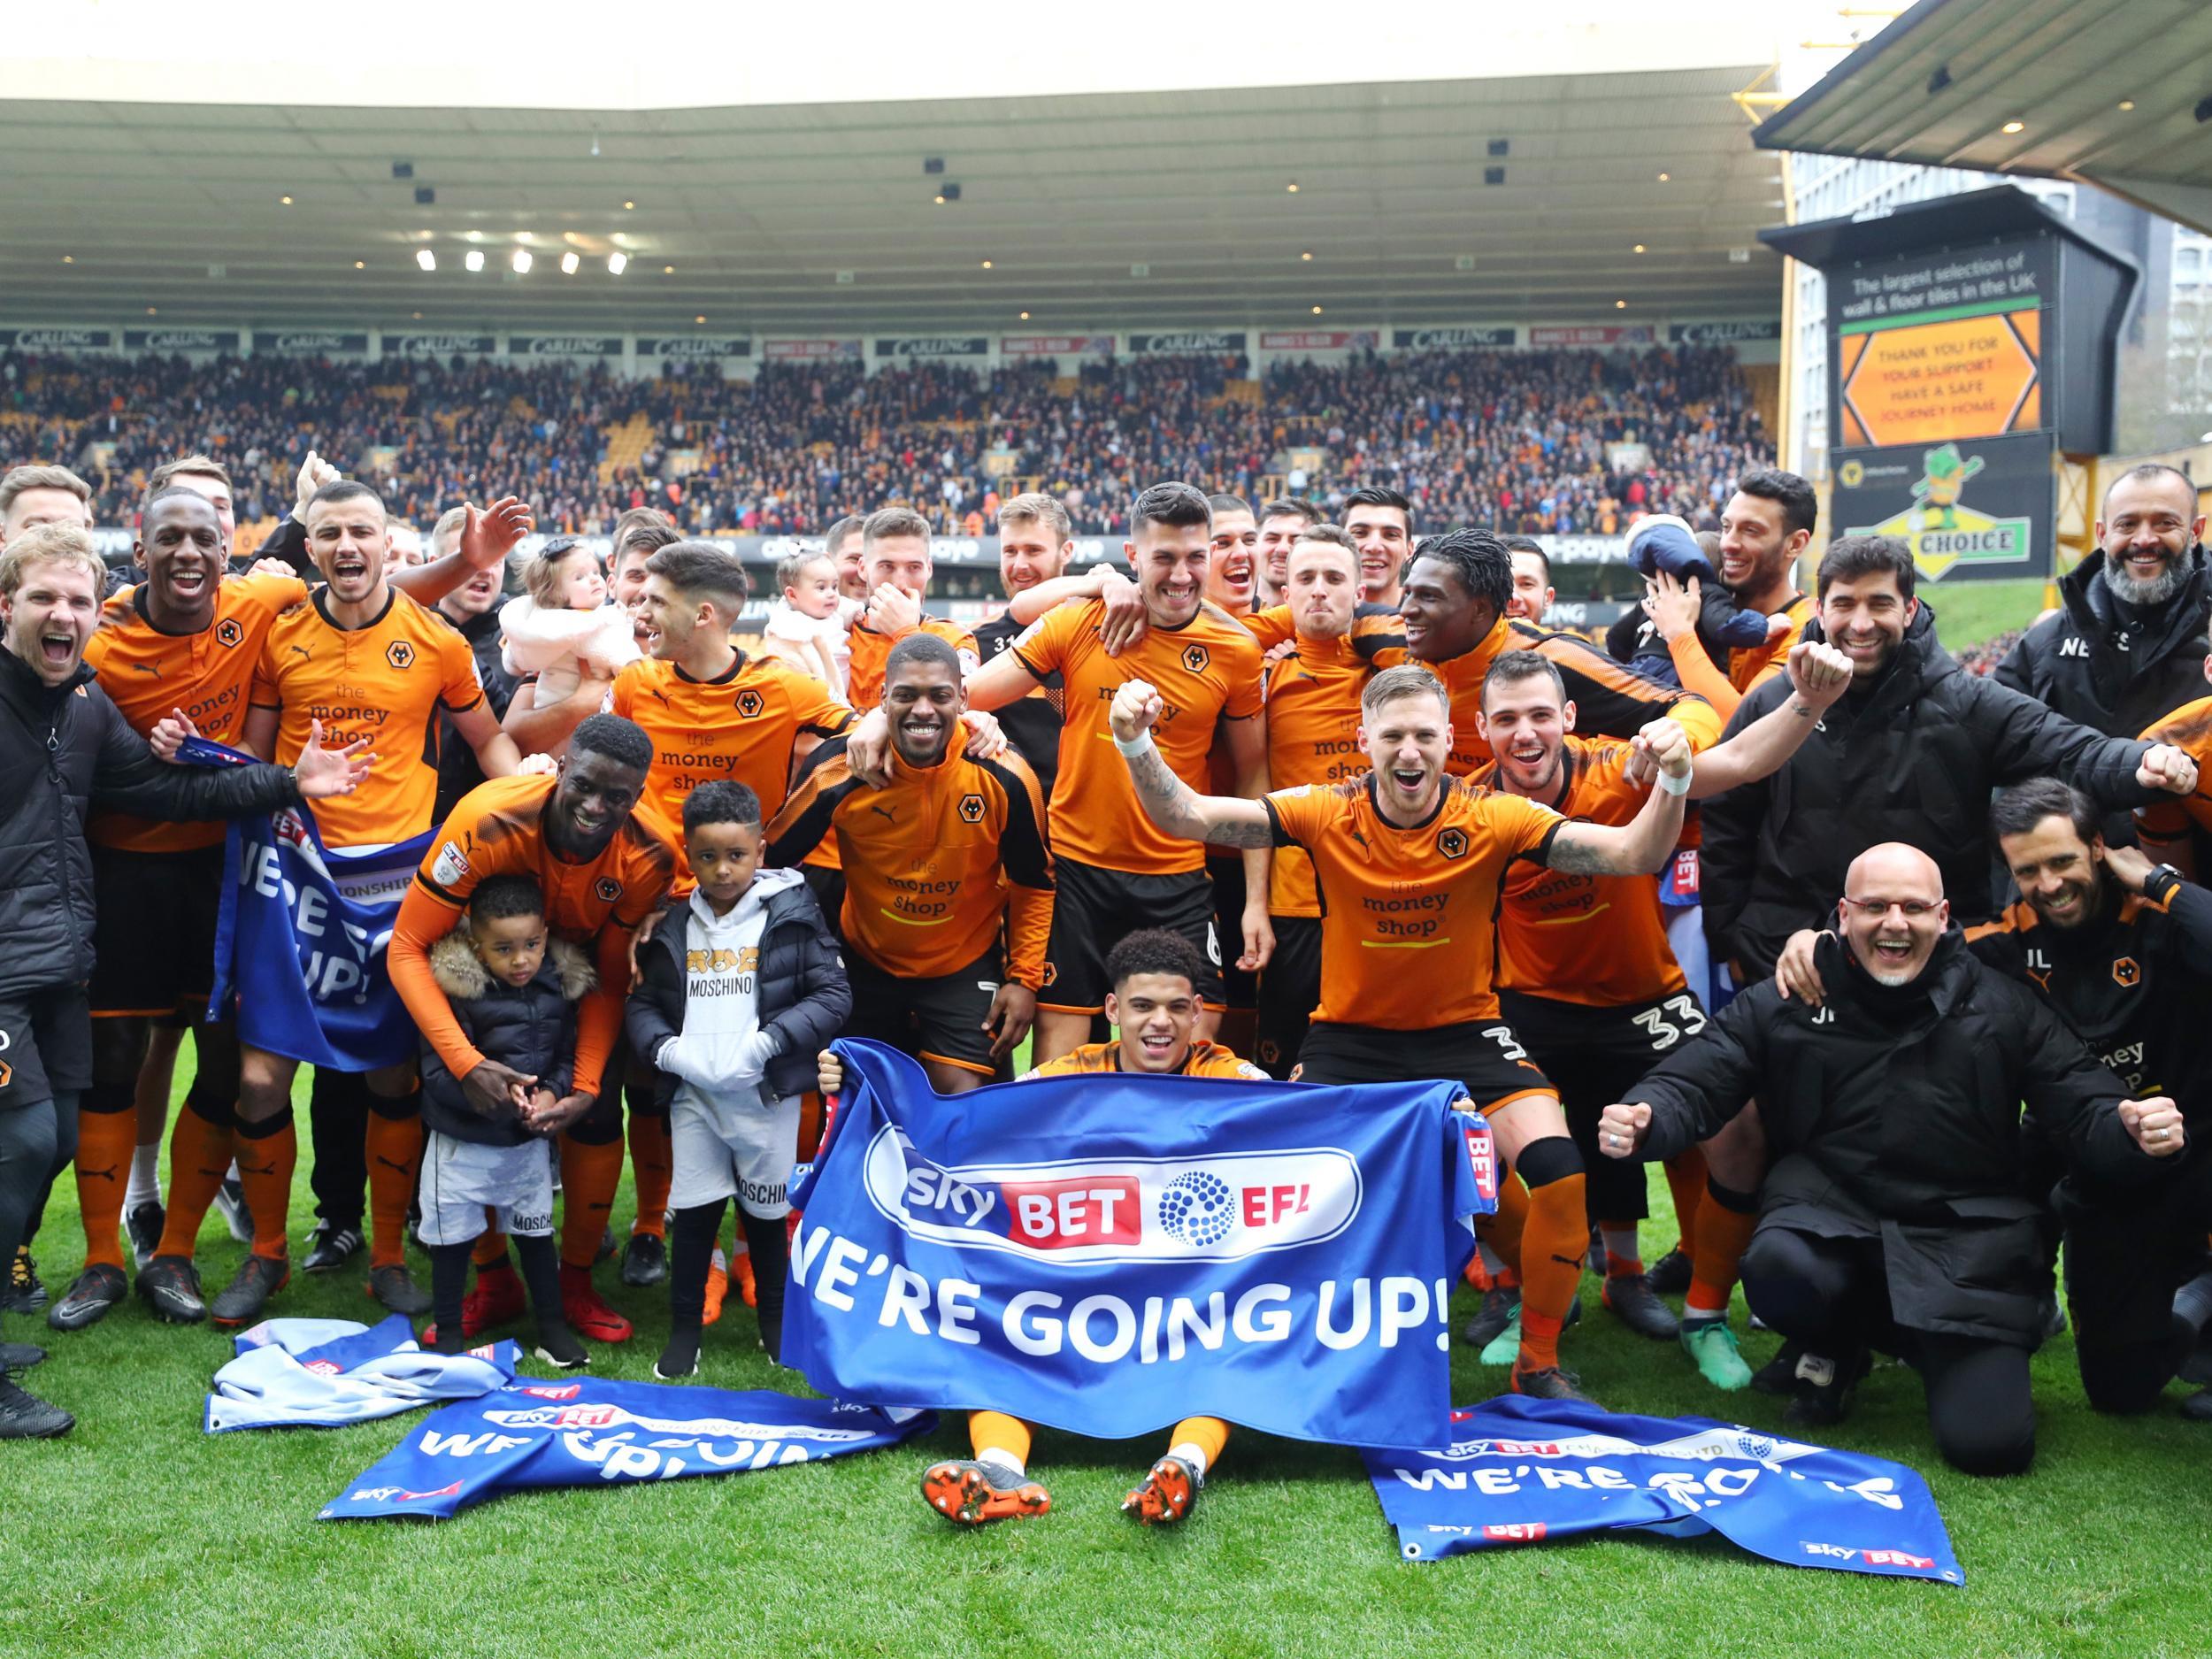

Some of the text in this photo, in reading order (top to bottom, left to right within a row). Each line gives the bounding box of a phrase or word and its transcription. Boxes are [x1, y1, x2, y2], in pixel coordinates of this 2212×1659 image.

[1853, 250, 2025, 296] The largest selection of
[1842, 272, 2037, 319] wall & floor tiles in the UK
[1879, 337, 1999, 364] THANK YOU FOR
[1883, 358, 1993, 382] YOUR SUPPORT
[1890, 380, 1984, 400] HAVE A SAFE
[1880, 400, 1997, 423] JOURNEY HOME
[1919, 531, 2014, 554] CHOICE
[335, 683, 365, 700] the
[197, 711, 234, 736] hop
[310, 704, 391, 726] money
[320, 726, 376, 747] shop
[686, 733, 715, 747] the
[661, 751, 740, 772] money
[1327, 762, 1374, 780] sho
[910, 857, 939, 875] the
[1678, 849, 1699, 888] BET
[886, 876, 962, 896] money
[1390, 879, 1423, 895] the
[893, 895, 947, 918] shop
[1362, 892, 1450, 913] money
[1540, 890, 1594, 915] shop
[1376, 918, 1438, 937] shop
[1206, 921, 1223, 967] 6
[2026, 949, 2053, 969] JL
[688, 976, 752, 998] MOSCHINO
[1632, 994, 1708, 1051] 33
[1480, 1025, 1528, 1061] 3
[2100, 1041, 2144, 1069] ney
[1468, 1137, 1493, 1192] BET
[737, 1175, 788, 1204] OSCHIN
[907, 1166, 1126, 1239] sky BET
[513, 1213, 553, 1231] MOSCH
[1002, 1283, 1292, 1364] GOING
[1315, 1277, 1450, 1352] UP!
[1446, 1442, 1489, 1458] sky
[1502, 1442, 1551, 1455] BET
[1394, 1464, 1642, 1495] WE'RE
[1806, 1543, 1929, 1569] sky BET
